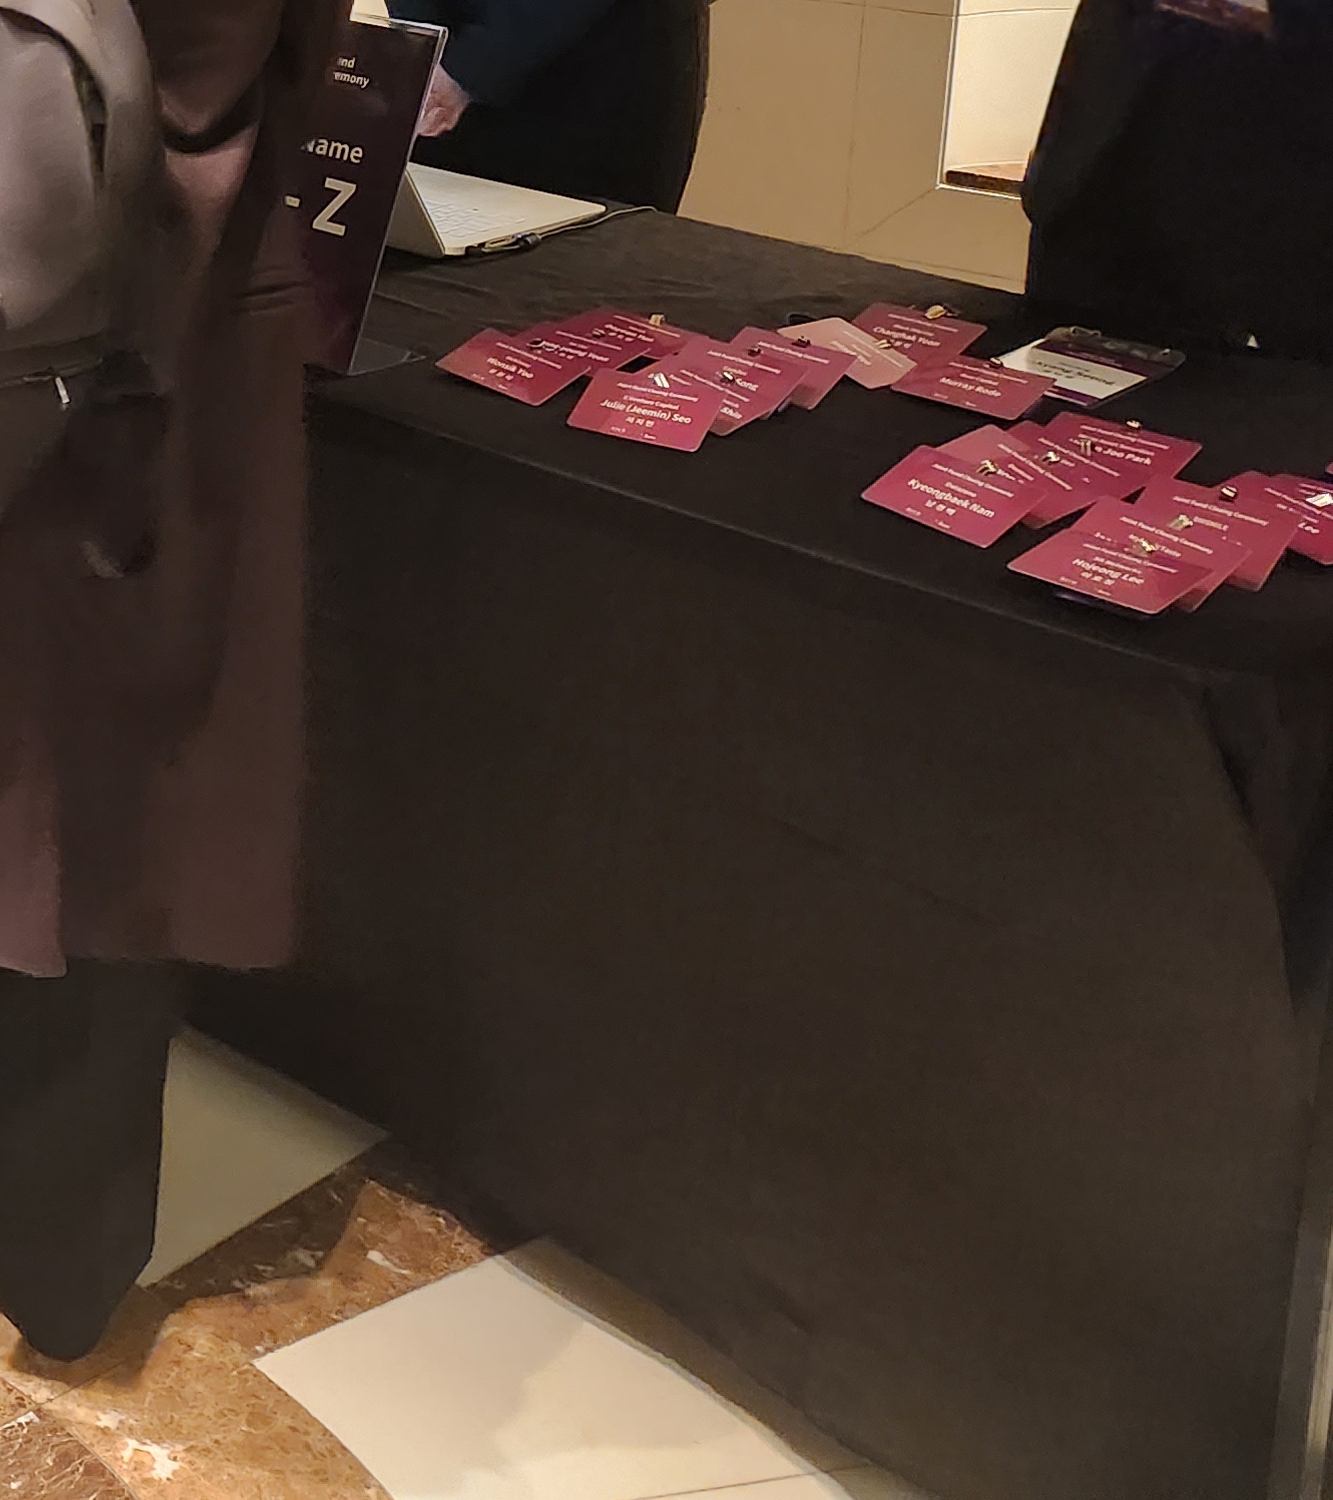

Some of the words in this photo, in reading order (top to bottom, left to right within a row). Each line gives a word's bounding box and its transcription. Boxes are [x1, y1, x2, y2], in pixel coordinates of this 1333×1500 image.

[333, 70, 370, 89] emony
[311, 176, 357, 237] Z
[671, 413, 692, 425] Seo
[1124, 450, 1152, 466] Park
